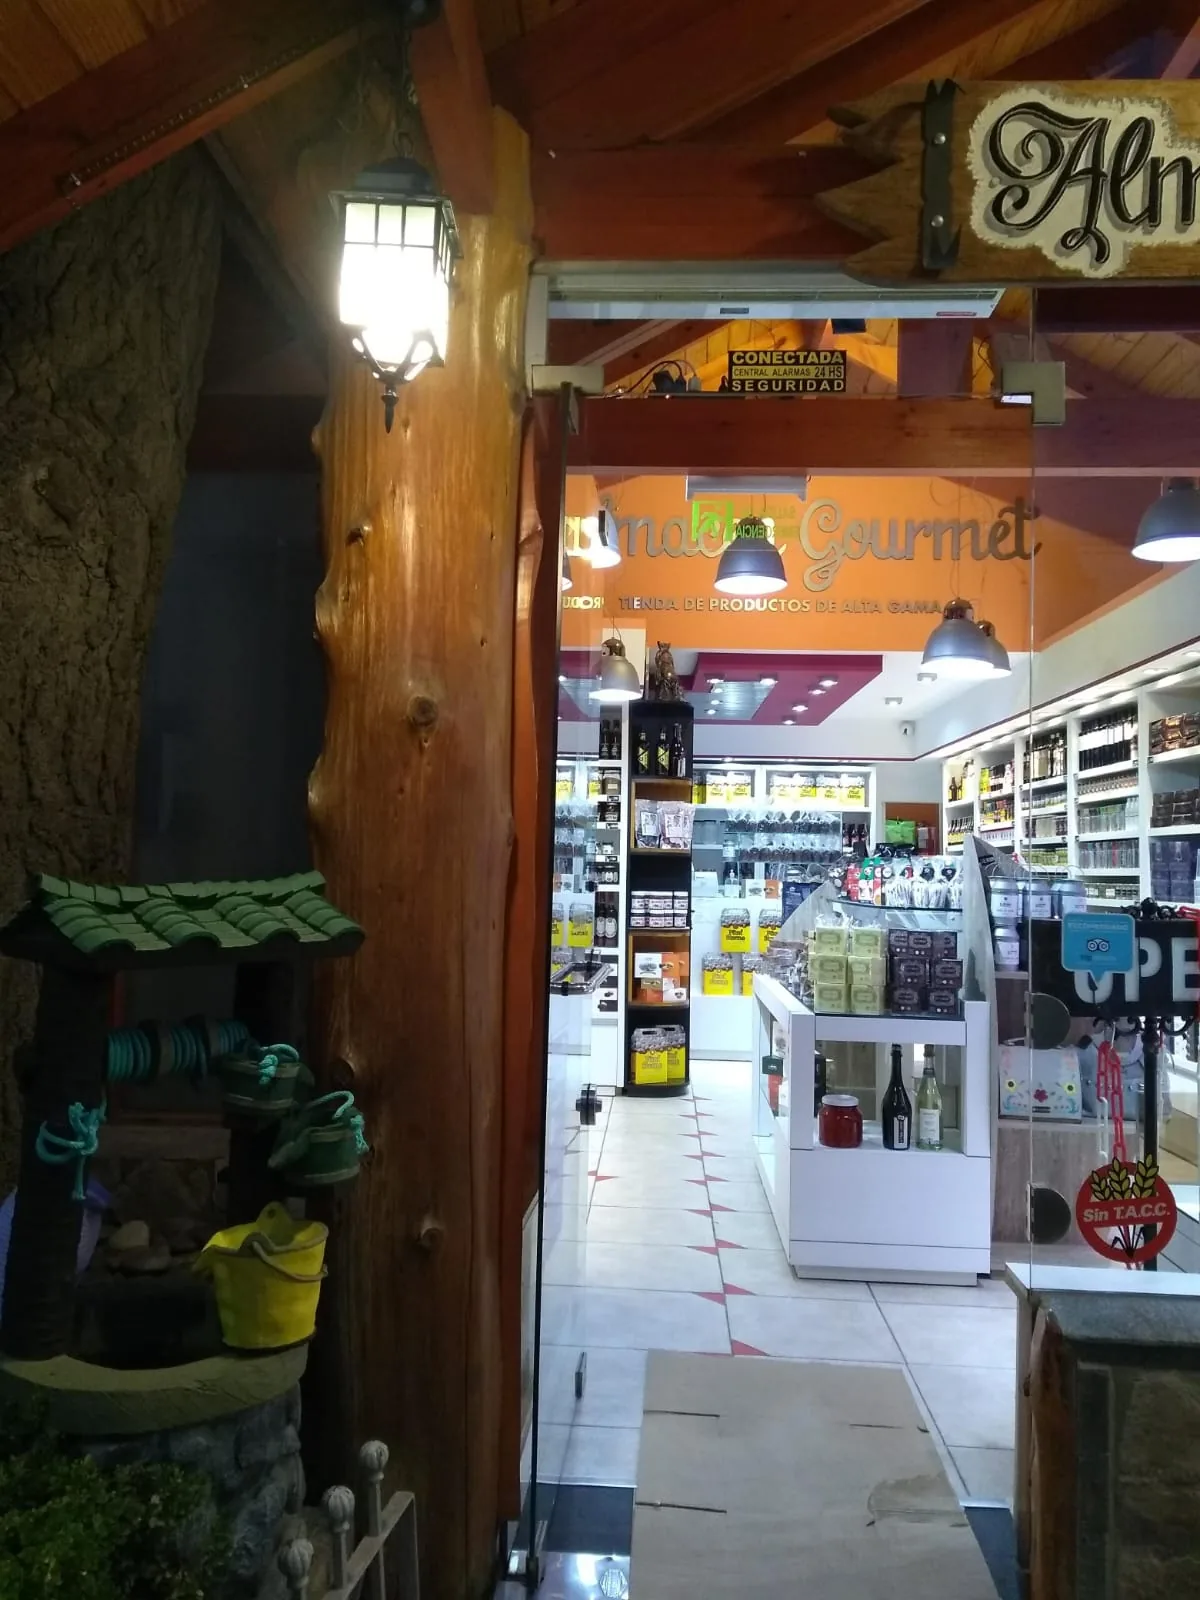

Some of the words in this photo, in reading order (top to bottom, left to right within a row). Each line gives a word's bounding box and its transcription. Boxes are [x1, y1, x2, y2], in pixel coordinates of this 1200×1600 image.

[732, 351, 843, 364] CONECTADA
[734, 368, 768, 377] CENTRAL
[773, 368, 810, 377] ALARMAS
[814, 366, 826, 378] 24
[829, 366, 842, 378] HS
[732, 380, 844, 391] SEGURIDAD
[618, 597, 679, 610] TIENDA
[683, 597, 705, 611] DE
[709, 597, 811, 612] PRODUCTOS
[816, 599, 837, 612] DE
[841, 599, 881, 613] ALTA
[888, 600, 942, 613] GAMA
[1083, 1209, 1109, 1222] Sin
